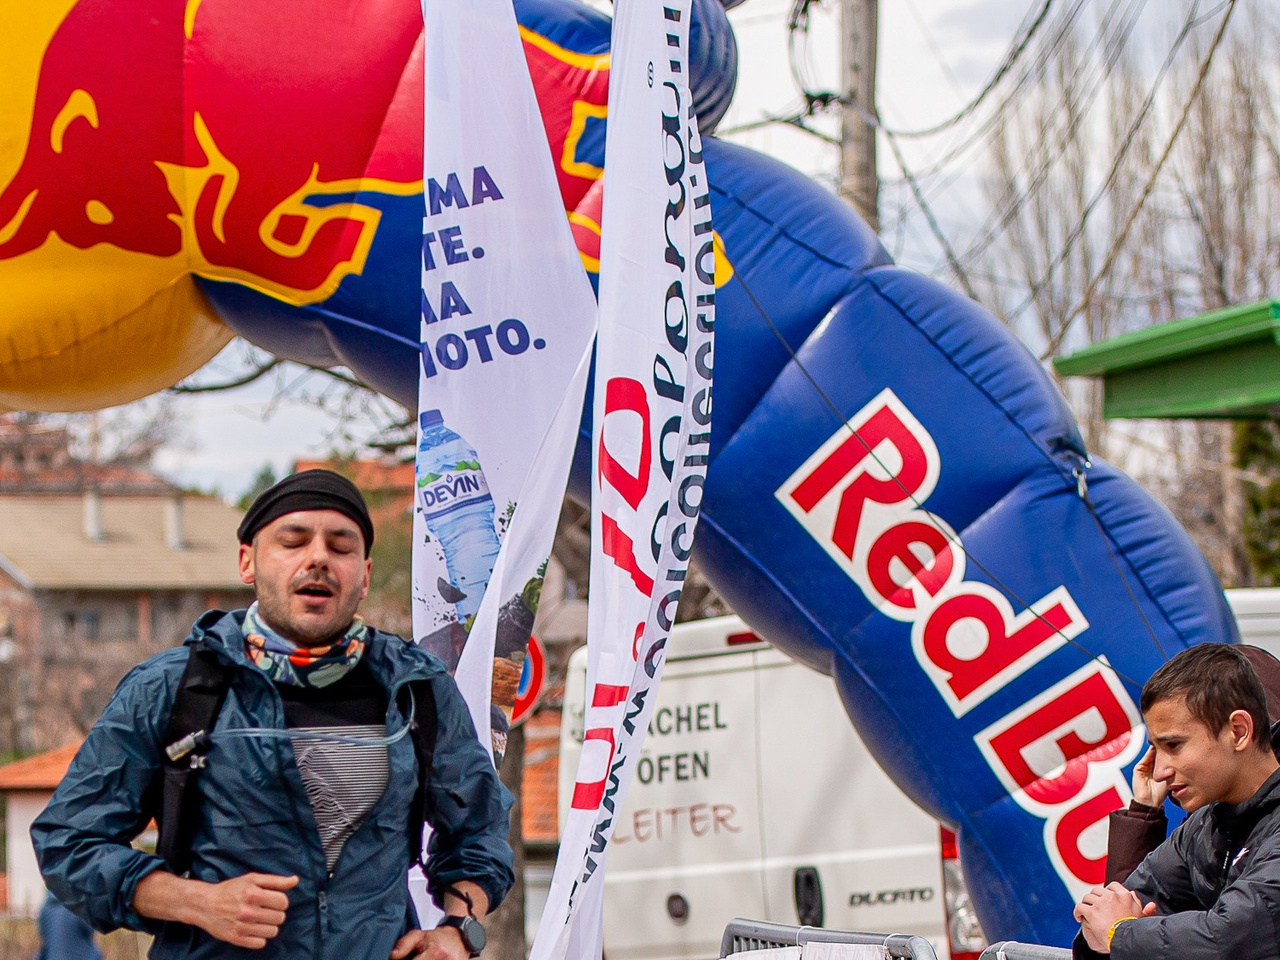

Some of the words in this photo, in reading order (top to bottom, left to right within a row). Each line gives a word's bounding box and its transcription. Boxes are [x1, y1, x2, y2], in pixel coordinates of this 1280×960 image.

[424, 165, 504, 218] МА
[423, 475, 480, 507] DEVIN
[782, 396, 1081, 710] Red
[982, 662, 1141, 890] Bu
[849, 886, 934, 907] DUCATO
